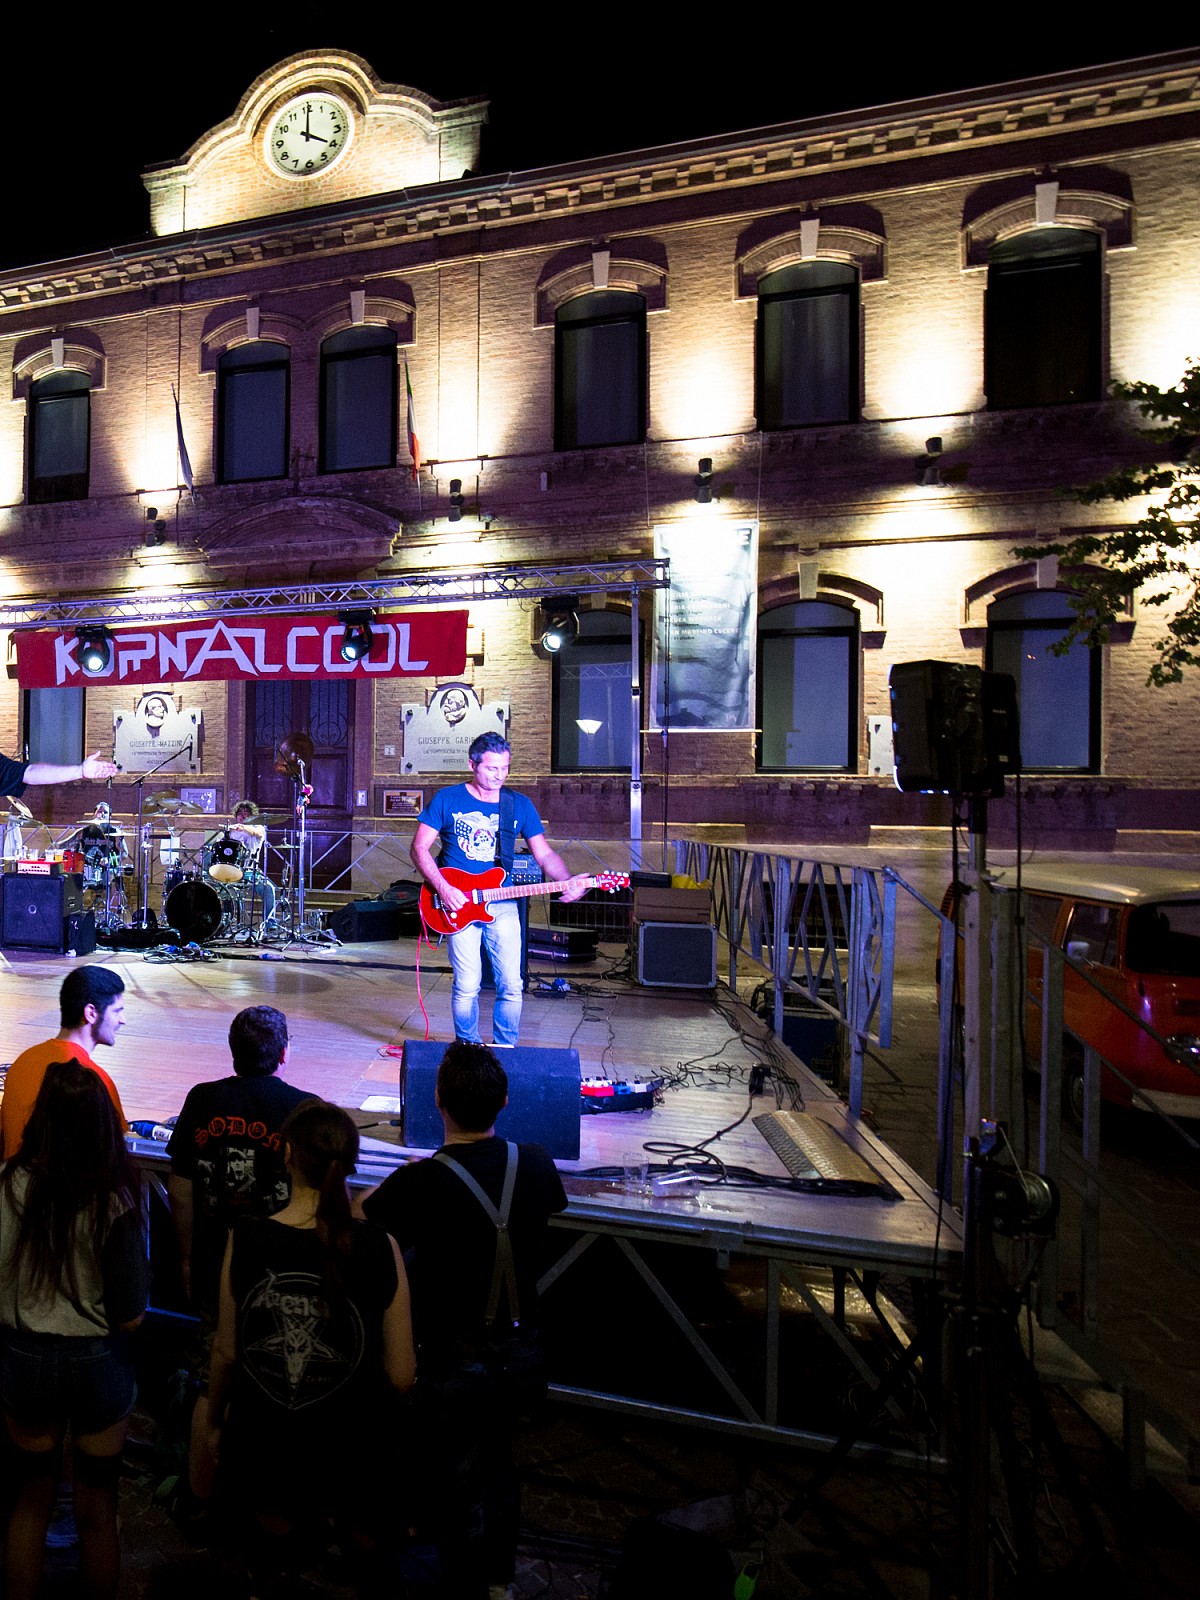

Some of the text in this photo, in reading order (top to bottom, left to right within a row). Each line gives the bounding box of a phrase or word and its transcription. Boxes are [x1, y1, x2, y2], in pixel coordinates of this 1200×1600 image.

[302, 104, 313, 114] 12
[320, 106, 324, 114] 1
[288, 113, 297, 122] 11
[330, 111, 337, 120] 2
[280, 125, 289, 134] 10
[333, 124, 341, 134] 3
[276, 140, 284, 149] 9
[329, 139, 338, 148] 4
[280, 151, 289, 160] 8
[320, 152, 327, 161] 5
[292, 159, 299, 168] 7
[305, 159, 314, 168] 6
[418, 736, 476, 745] GIUSEPPE GARIB
